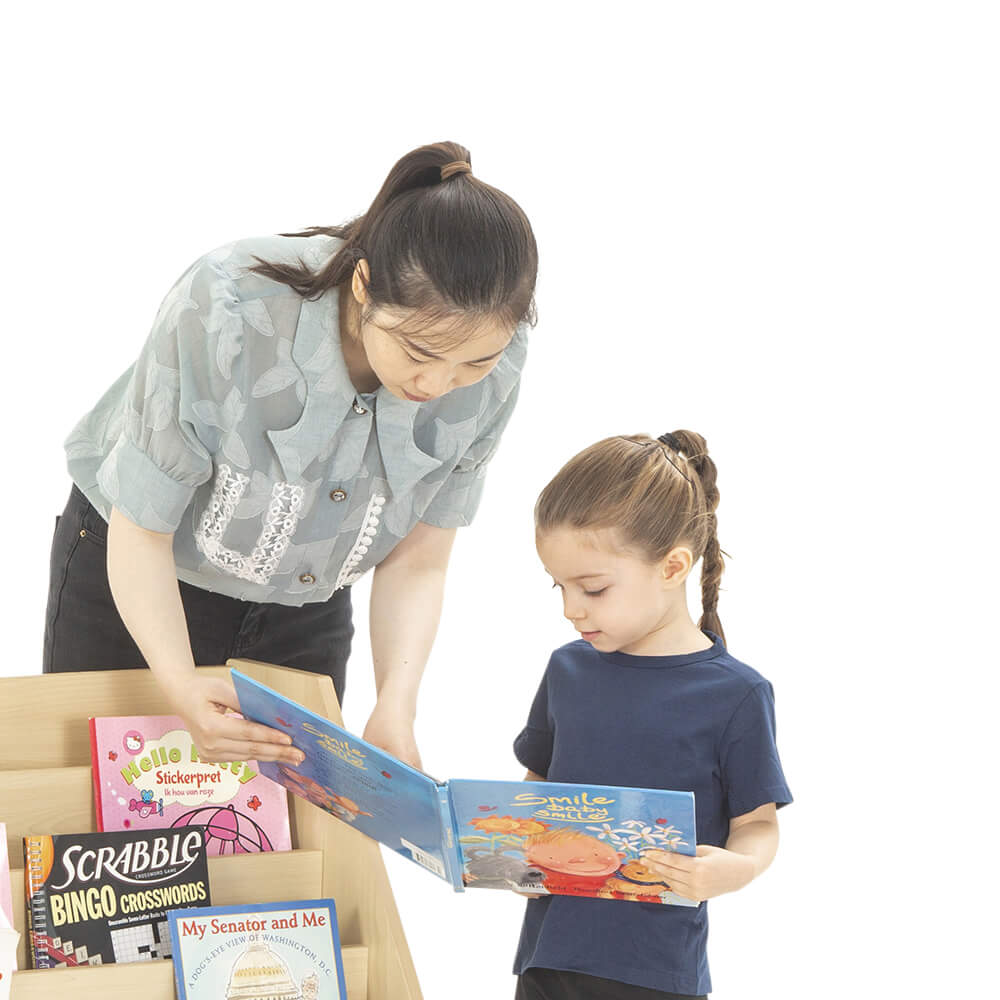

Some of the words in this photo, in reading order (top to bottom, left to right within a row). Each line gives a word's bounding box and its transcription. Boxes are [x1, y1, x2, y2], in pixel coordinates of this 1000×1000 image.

[120, 746, 182, 786] Hello
[155, 770, 222, 788] Stickerpret
[508, 792, 616, 807] Smile
[50, 884, 117, 927] BINGO
[120, 881, 207, 914] CROSSWORDS
[182, 920, 207, 941] My
[210, 918, 267, 935] Senator
[271, 913, 298, 930] and
[302, 912, 326, 928] Me
[225, 935, 247, 949] VIEW
